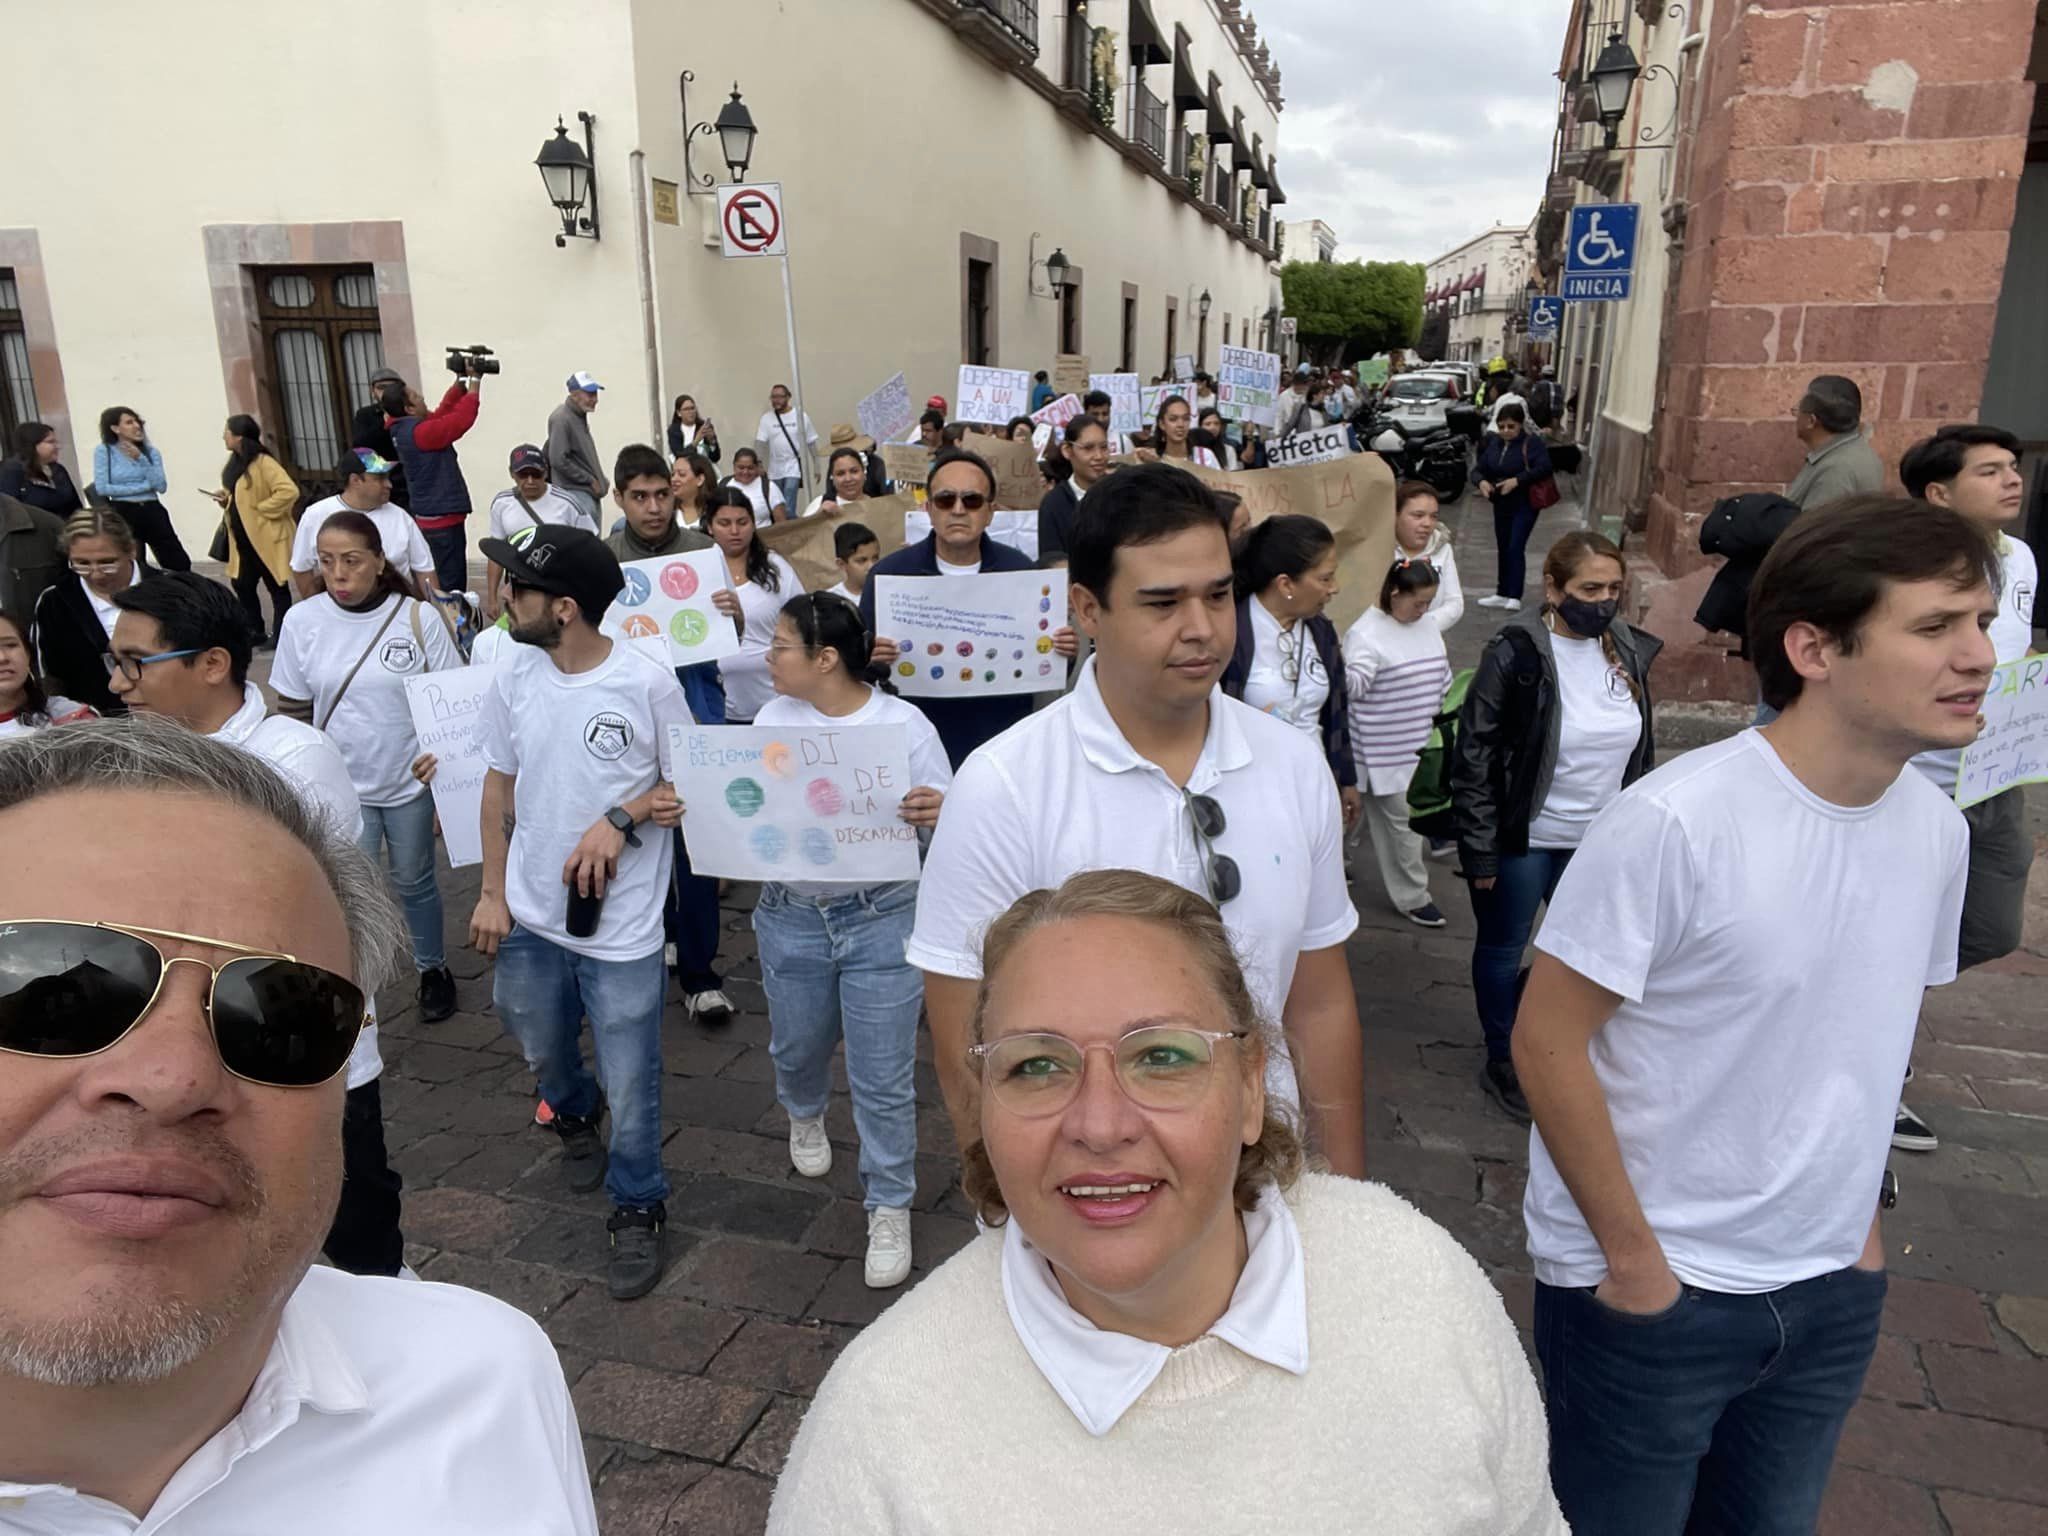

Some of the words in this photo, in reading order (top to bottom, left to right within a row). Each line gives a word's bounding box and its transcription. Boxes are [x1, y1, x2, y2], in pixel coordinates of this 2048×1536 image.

[1568, 278, 1624, 296] INICIA
[974, 387, 984, 401] A
[991, 388, 1013, 405] UN
[1267, 433, 1342, 464] effeta
[1322, 472, 1357, 509] LA
[669, 728, 682, 749] 3
[688, 734, 707, 750] DE
[853, 766, 894, 794] DE
[1983, 752, 2040, 791] Todos
[851, 795, 879, 816] LA
